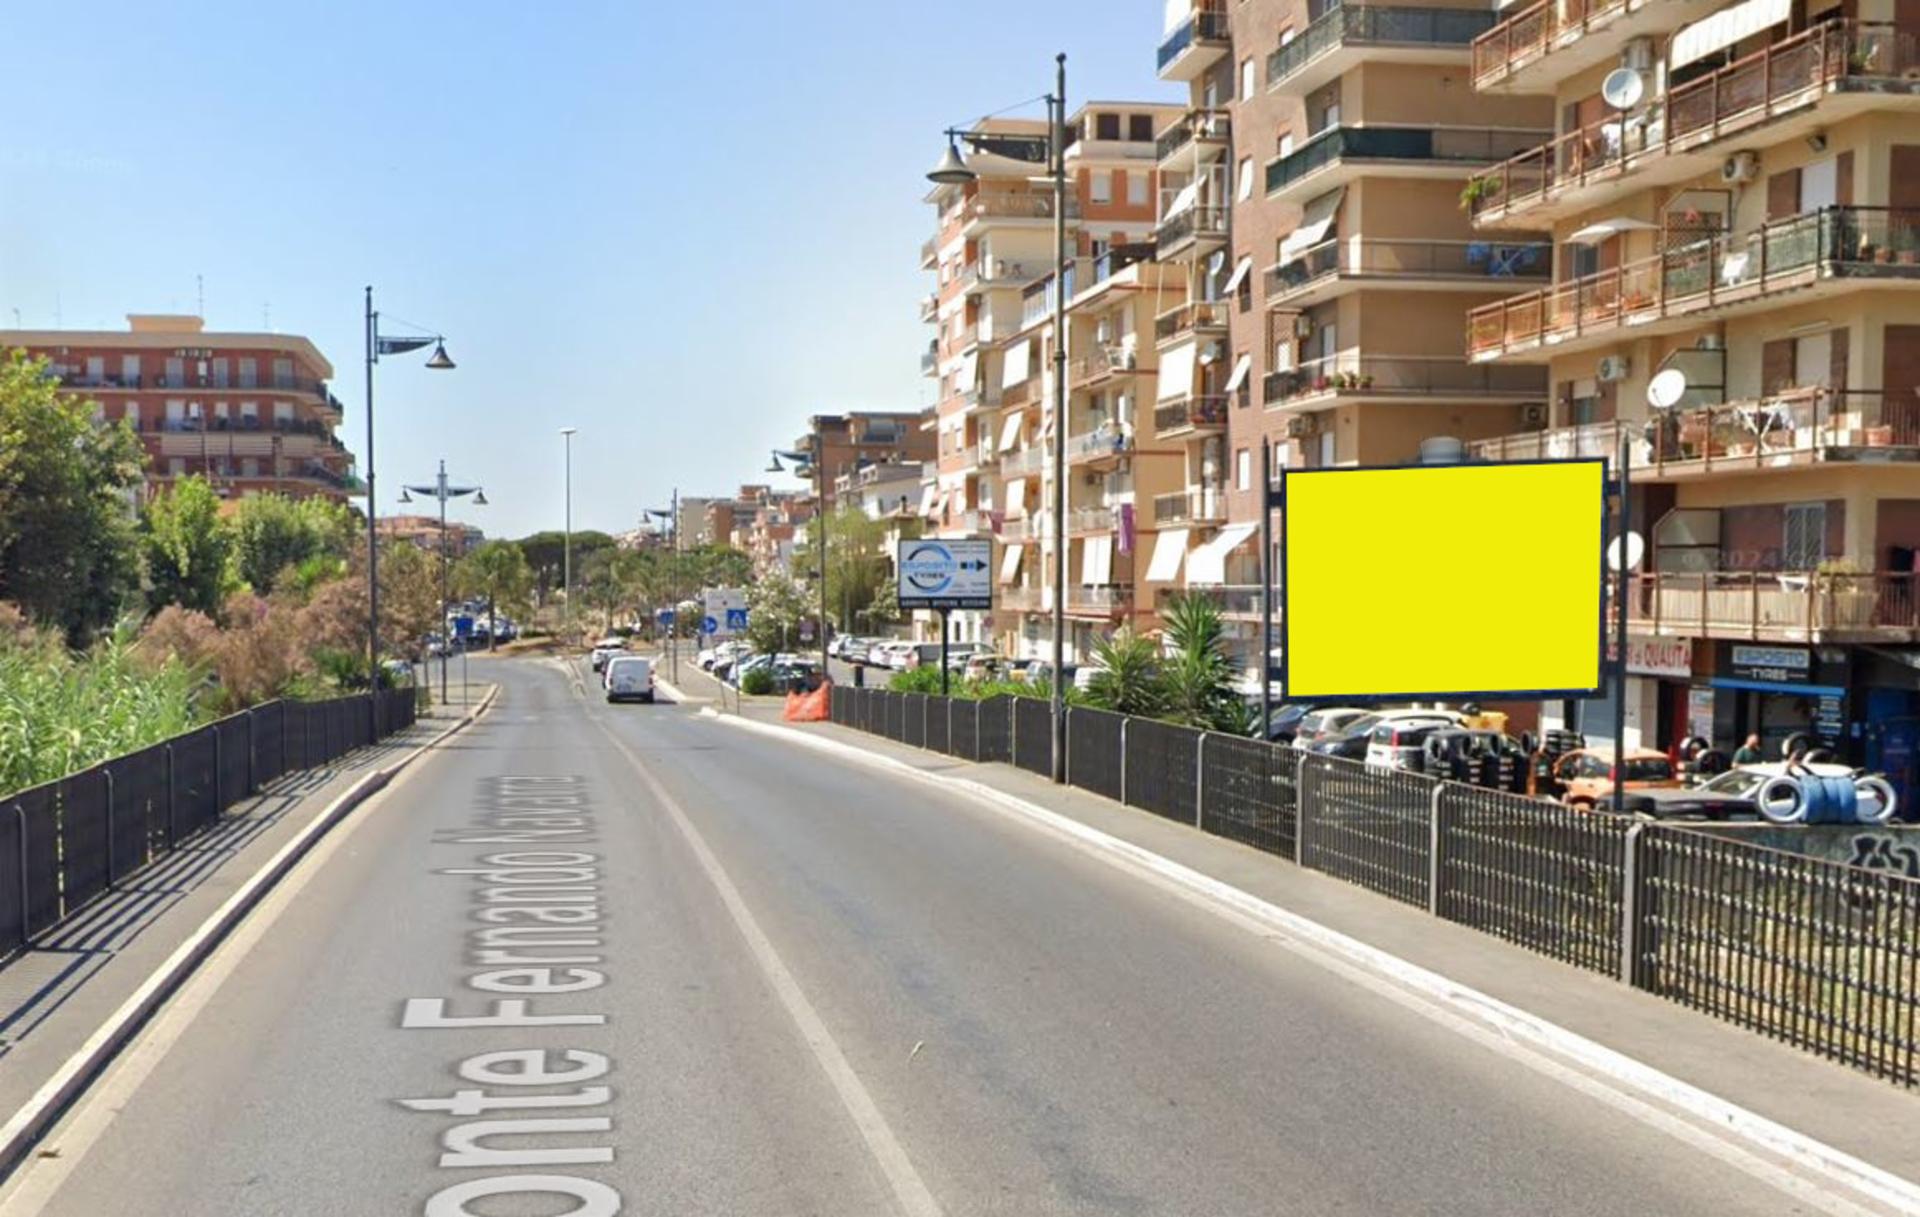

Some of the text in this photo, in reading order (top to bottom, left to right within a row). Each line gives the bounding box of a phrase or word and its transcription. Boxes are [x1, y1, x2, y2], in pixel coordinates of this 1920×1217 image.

[913, 571, 945, 579] TYRES
[1735, 648, 1806, 667] ESPOSITO
[1752, 668, 1787, 680] TYRES
